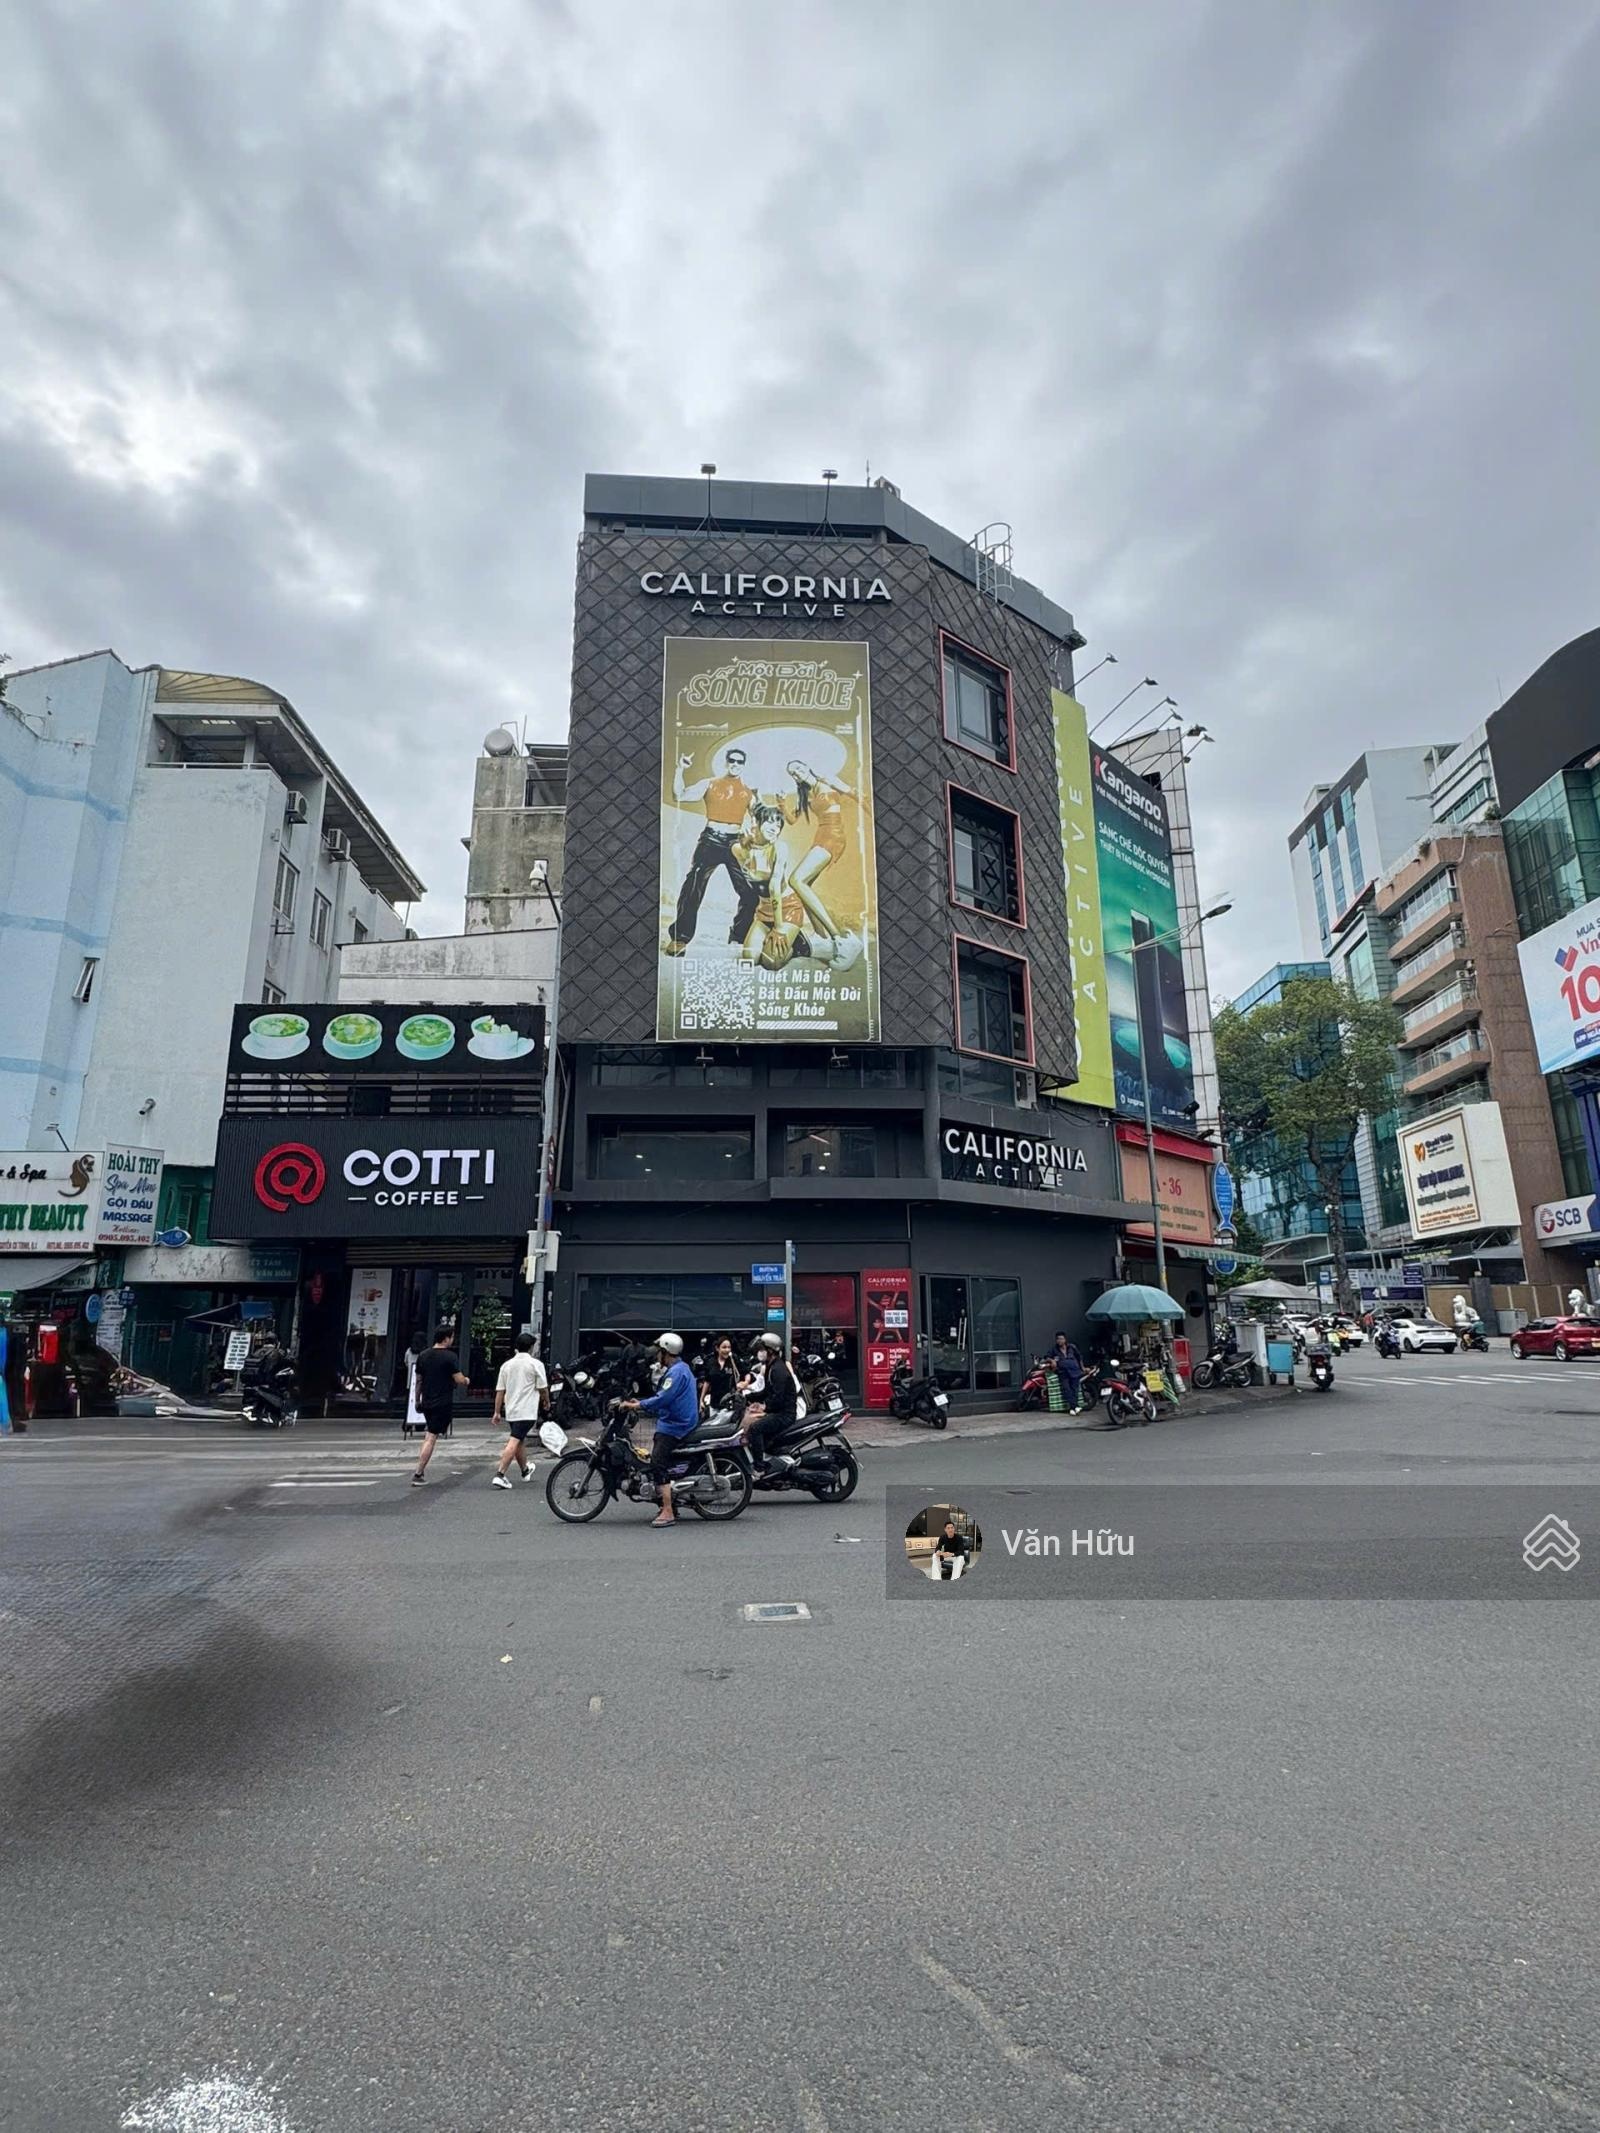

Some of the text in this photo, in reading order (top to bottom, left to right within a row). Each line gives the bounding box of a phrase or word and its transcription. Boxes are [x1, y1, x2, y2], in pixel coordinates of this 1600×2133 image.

[640, 571, 892, 600] CALIFORNIA
[691, 600, 845, 617] ACTIVE
[688, 668, 854, 710] SỐNG KHỎE
[1094, 754, 1162, 821] Kangaroo
[1069, 785, 1098, 1003] ACTIVE
[1576, 922, 1596, 939] MUA
[758, 967, 832, 984] Quét Mã Để
[758, 983, 780, 1000] Bắt
[812, 987, 837, 1004] Một
[840, 986, 861, 1001] Đời
[758, 1001, 826, 1019] Sống Khỏe
[945, 1128, 1088, 1172] CALIFORNIA
[19, 1163, 47, 1183] Spa
[138, 1156, 161, 1175] THY
[343, 1149, 496, 1187] COTTI
[975, 1162, 1064, 1187] ACTIVE
[107, 1196, 127, 1210] GỘI
[374, 1191, 459, 1206] COFFEE
[28, 1204, 89, 1232] BEAUTY
[103, 1211, 153, 1223] MASSAGE
[1555, 1207, 1582, 1228] SCB
